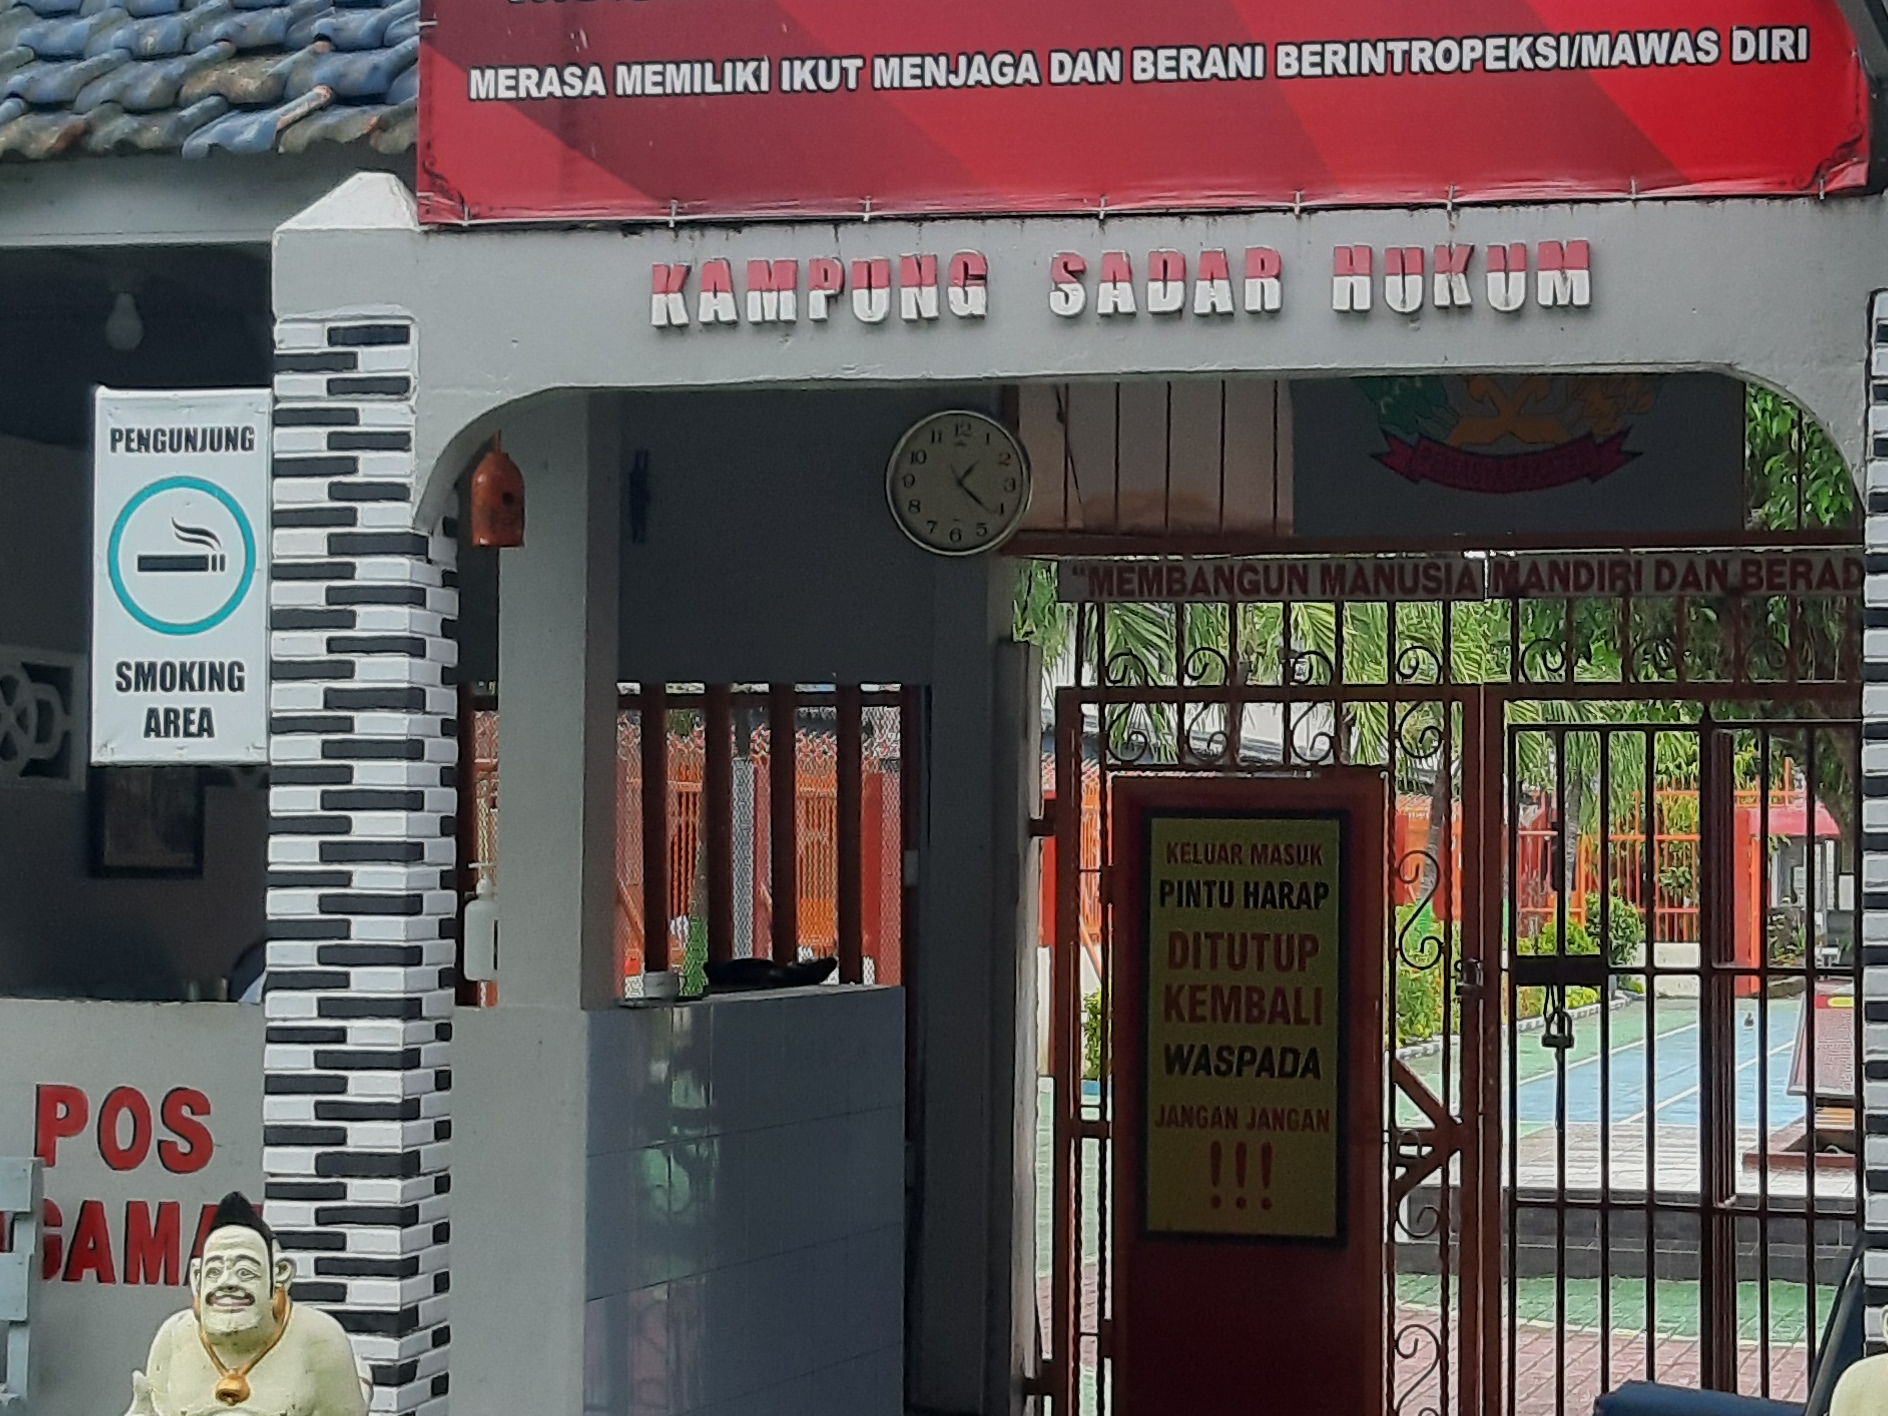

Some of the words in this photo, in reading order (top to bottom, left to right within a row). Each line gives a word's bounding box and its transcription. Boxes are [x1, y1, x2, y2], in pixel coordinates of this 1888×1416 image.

[468, 65, 606, 100] MERASA
[615, 57, 771, 96] MEMILIKI
[781, 56, 865, 92] IKUT
[872, 50, 1040, 90] MENJAGA
[1049, 48, 1123, 85] DAN
[1131, 45, 1265, 82] BERANI
[1275, 30, 1721, 77] BERINTROPEKSI/MAWAS
[1731, 26, 1809, 62] DIRI
[650, 250, 987, 329] KAMPUNG
[1049, 246, 1283, 317] SADAR
[1332, 239, 1590, 314] HUKUM
[110, 426, 256, 453] PENGUNJUNG
[930, 429, 942, 444] 11
[955, 422, 971, 437] 12
[910, 448, 927, 465] 10
[998, 452, 1011, 466] 2
[908, 499, 921, 514] 8
[926, 520, 937, 534] 7
[950, 528, 961, 543] 6
[976, 522, 987, 537] 5
[1319, 559, 1483, 596] MANUSIA
[1488, 557, 1644, 593] MANDIRI
[1653, 558, 1729, 593] DAN
[115, 660, 246, 693] SMOKING
[144, 707, 215, 738] AREA
[1166, 841, 1243, 866] KELUAR
[1250, 842, 1323, 867] MASUK
[1159, 879, 1235, 909] PINTU
[1243, 880, 1329, 911] HARAP
[1167, 931, 1320, 973] DITUTUP
[1163, 984, 1323, 1026] KEMBALI
[1163, 1044, 1321, 1081] WASPADA
[33, 1083, 214, 1174] POS
[1155, 1105, 1238, 1131] JANGAN
[1245, 1106, 1330, 1133] JANGAN
